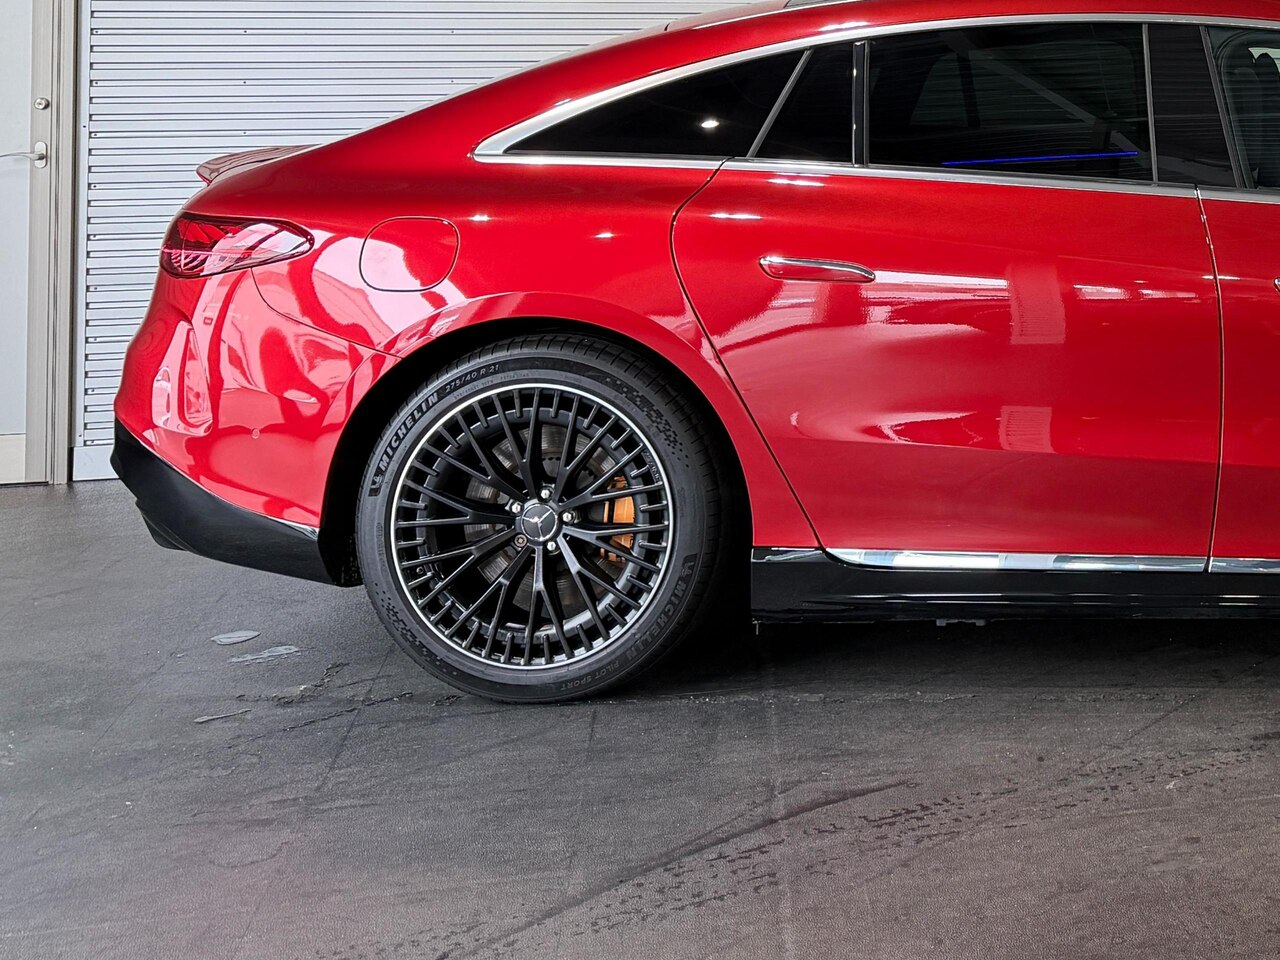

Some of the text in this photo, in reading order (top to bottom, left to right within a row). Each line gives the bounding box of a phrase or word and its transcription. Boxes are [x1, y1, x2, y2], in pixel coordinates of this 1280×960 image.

[378, 391, 440, 473] MICHELIN
[444, 371, 478, 393] 275/40
[488, 364, 500, 374] 21
[560, 581, 687, 691] MICHELIN PILOT SPORT
